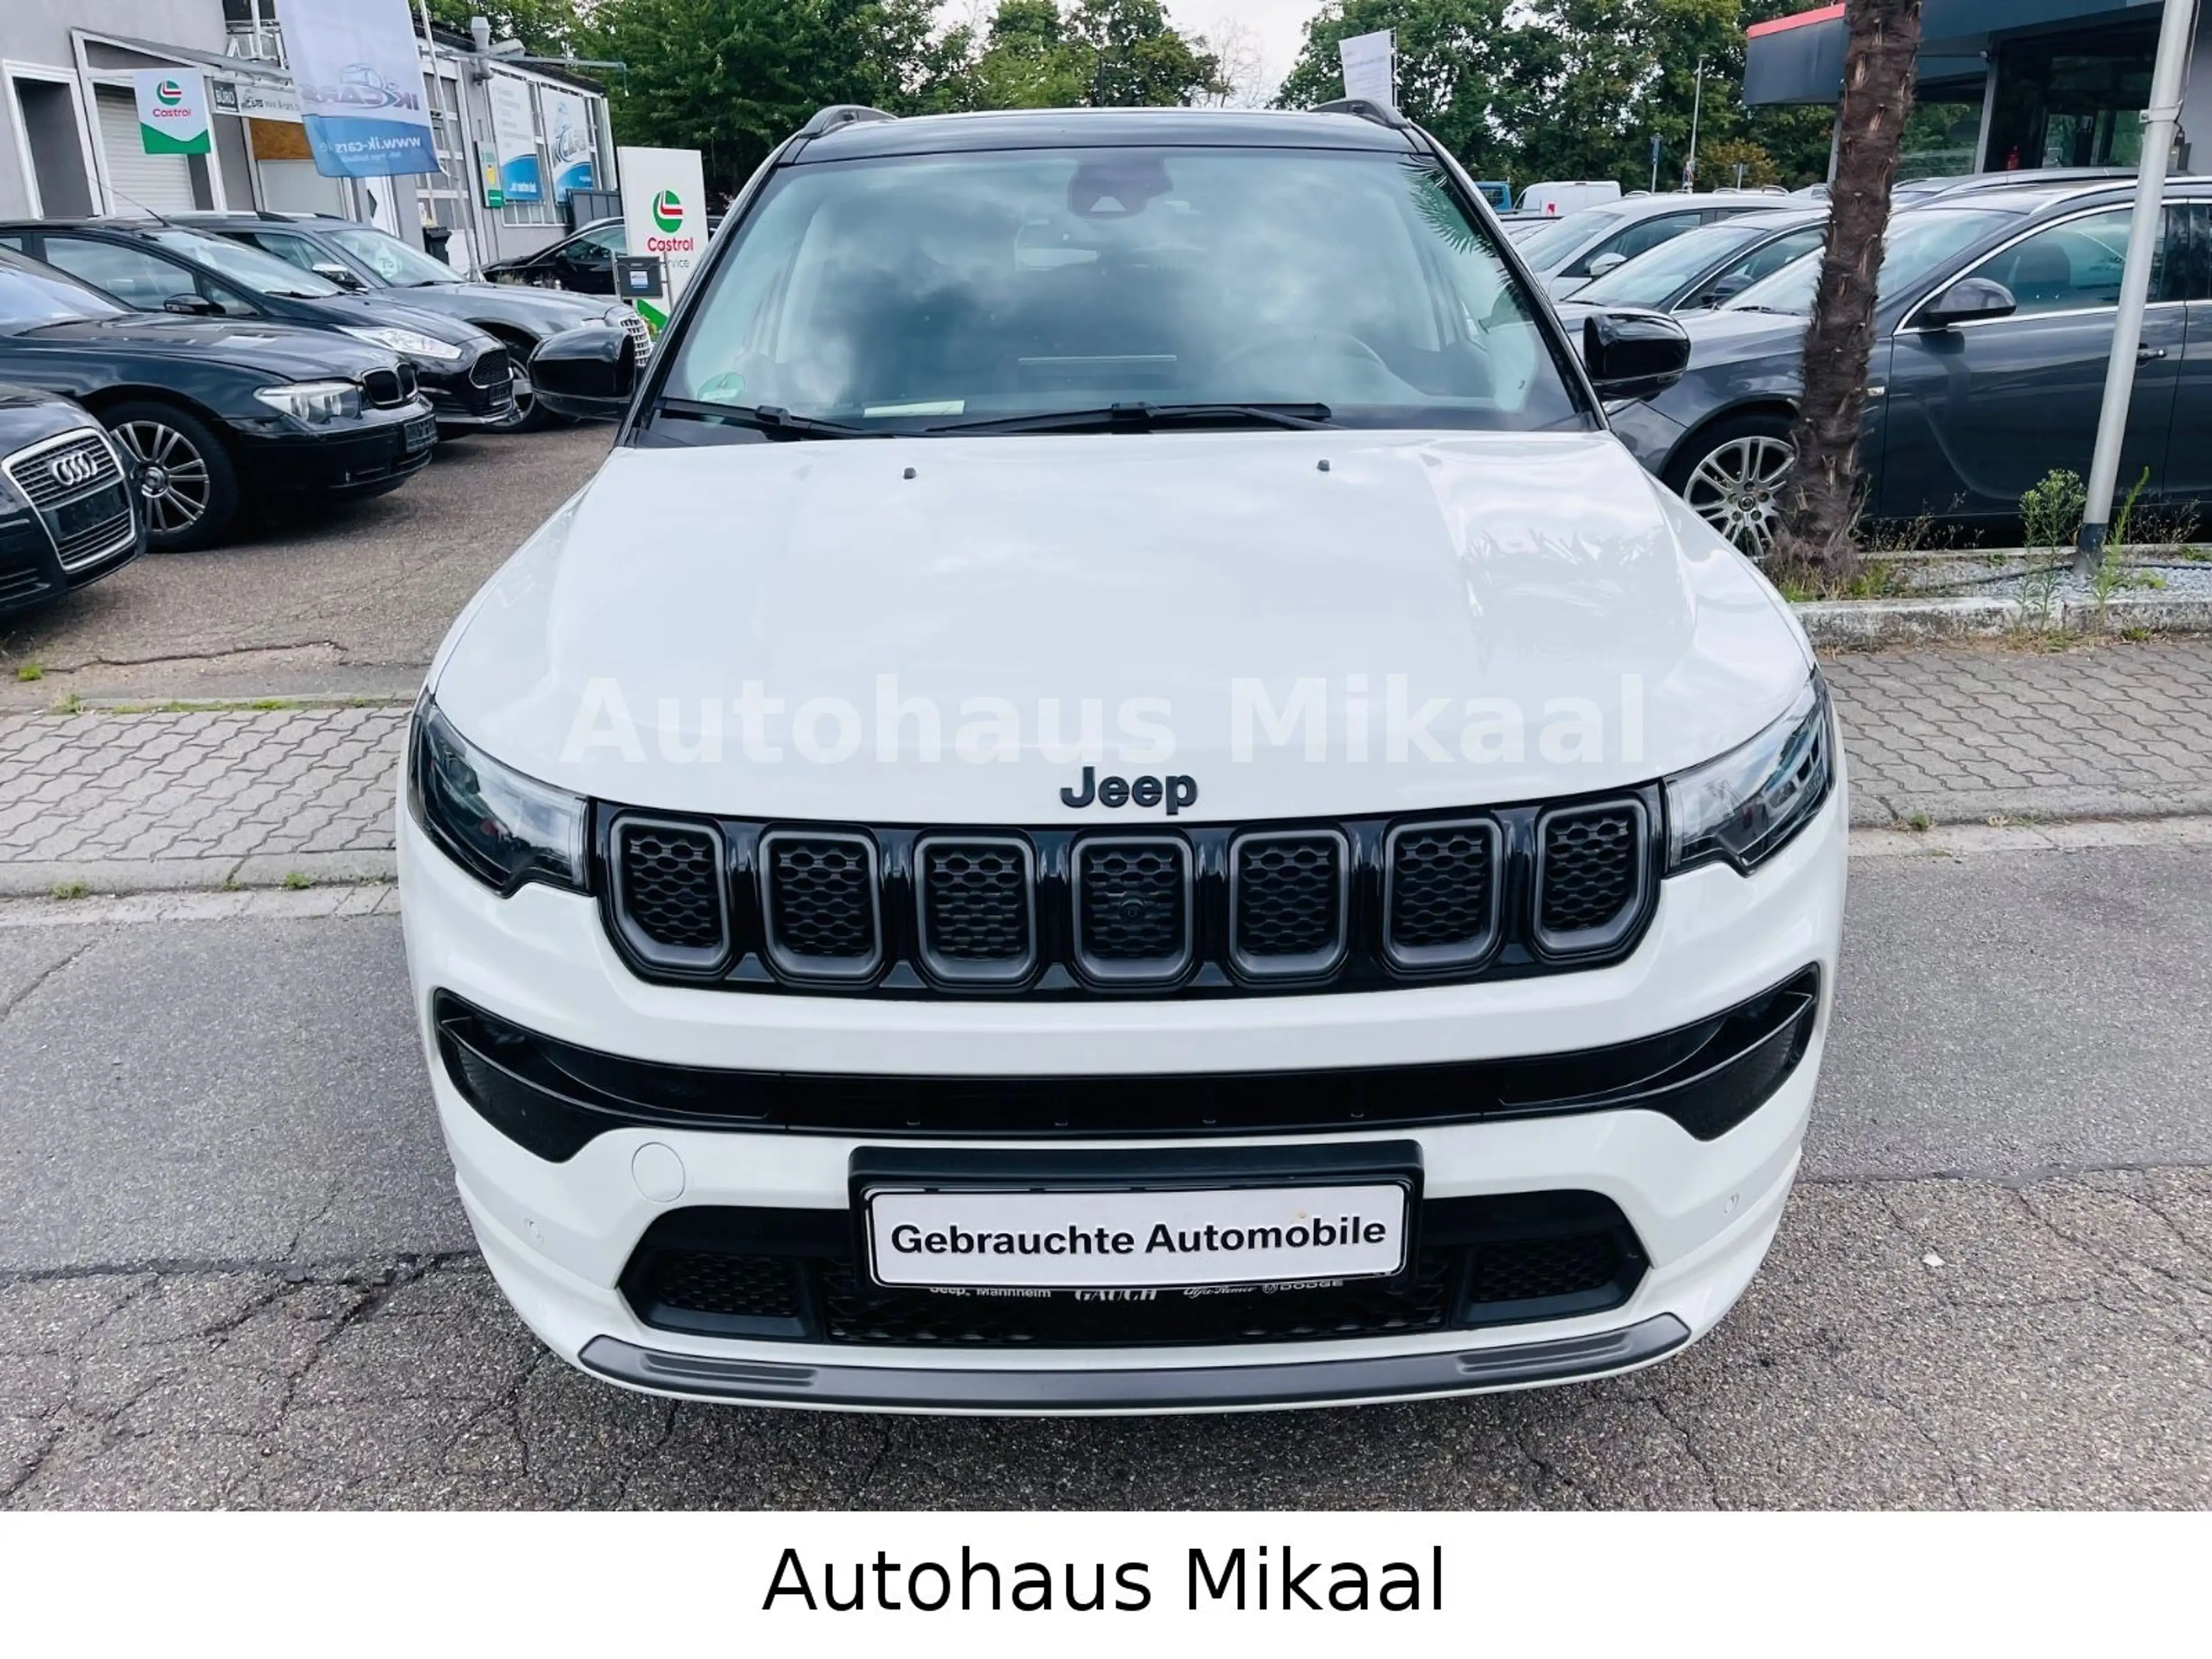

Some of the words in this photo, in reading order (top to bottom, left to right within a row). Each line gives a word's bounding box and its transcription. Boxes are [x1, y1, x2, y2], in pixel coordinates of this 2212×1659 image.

[153, 108, 191, 117] Castrol
[647, 237, 694, 251] Castrol
[667, 259, 690, 268] rvice
[1060, 766, 1198, 816] Jeep
[891, 1224, 1135, 1255] Gebrauchte
[1145, 1215, 1387, 1253] Automobile
